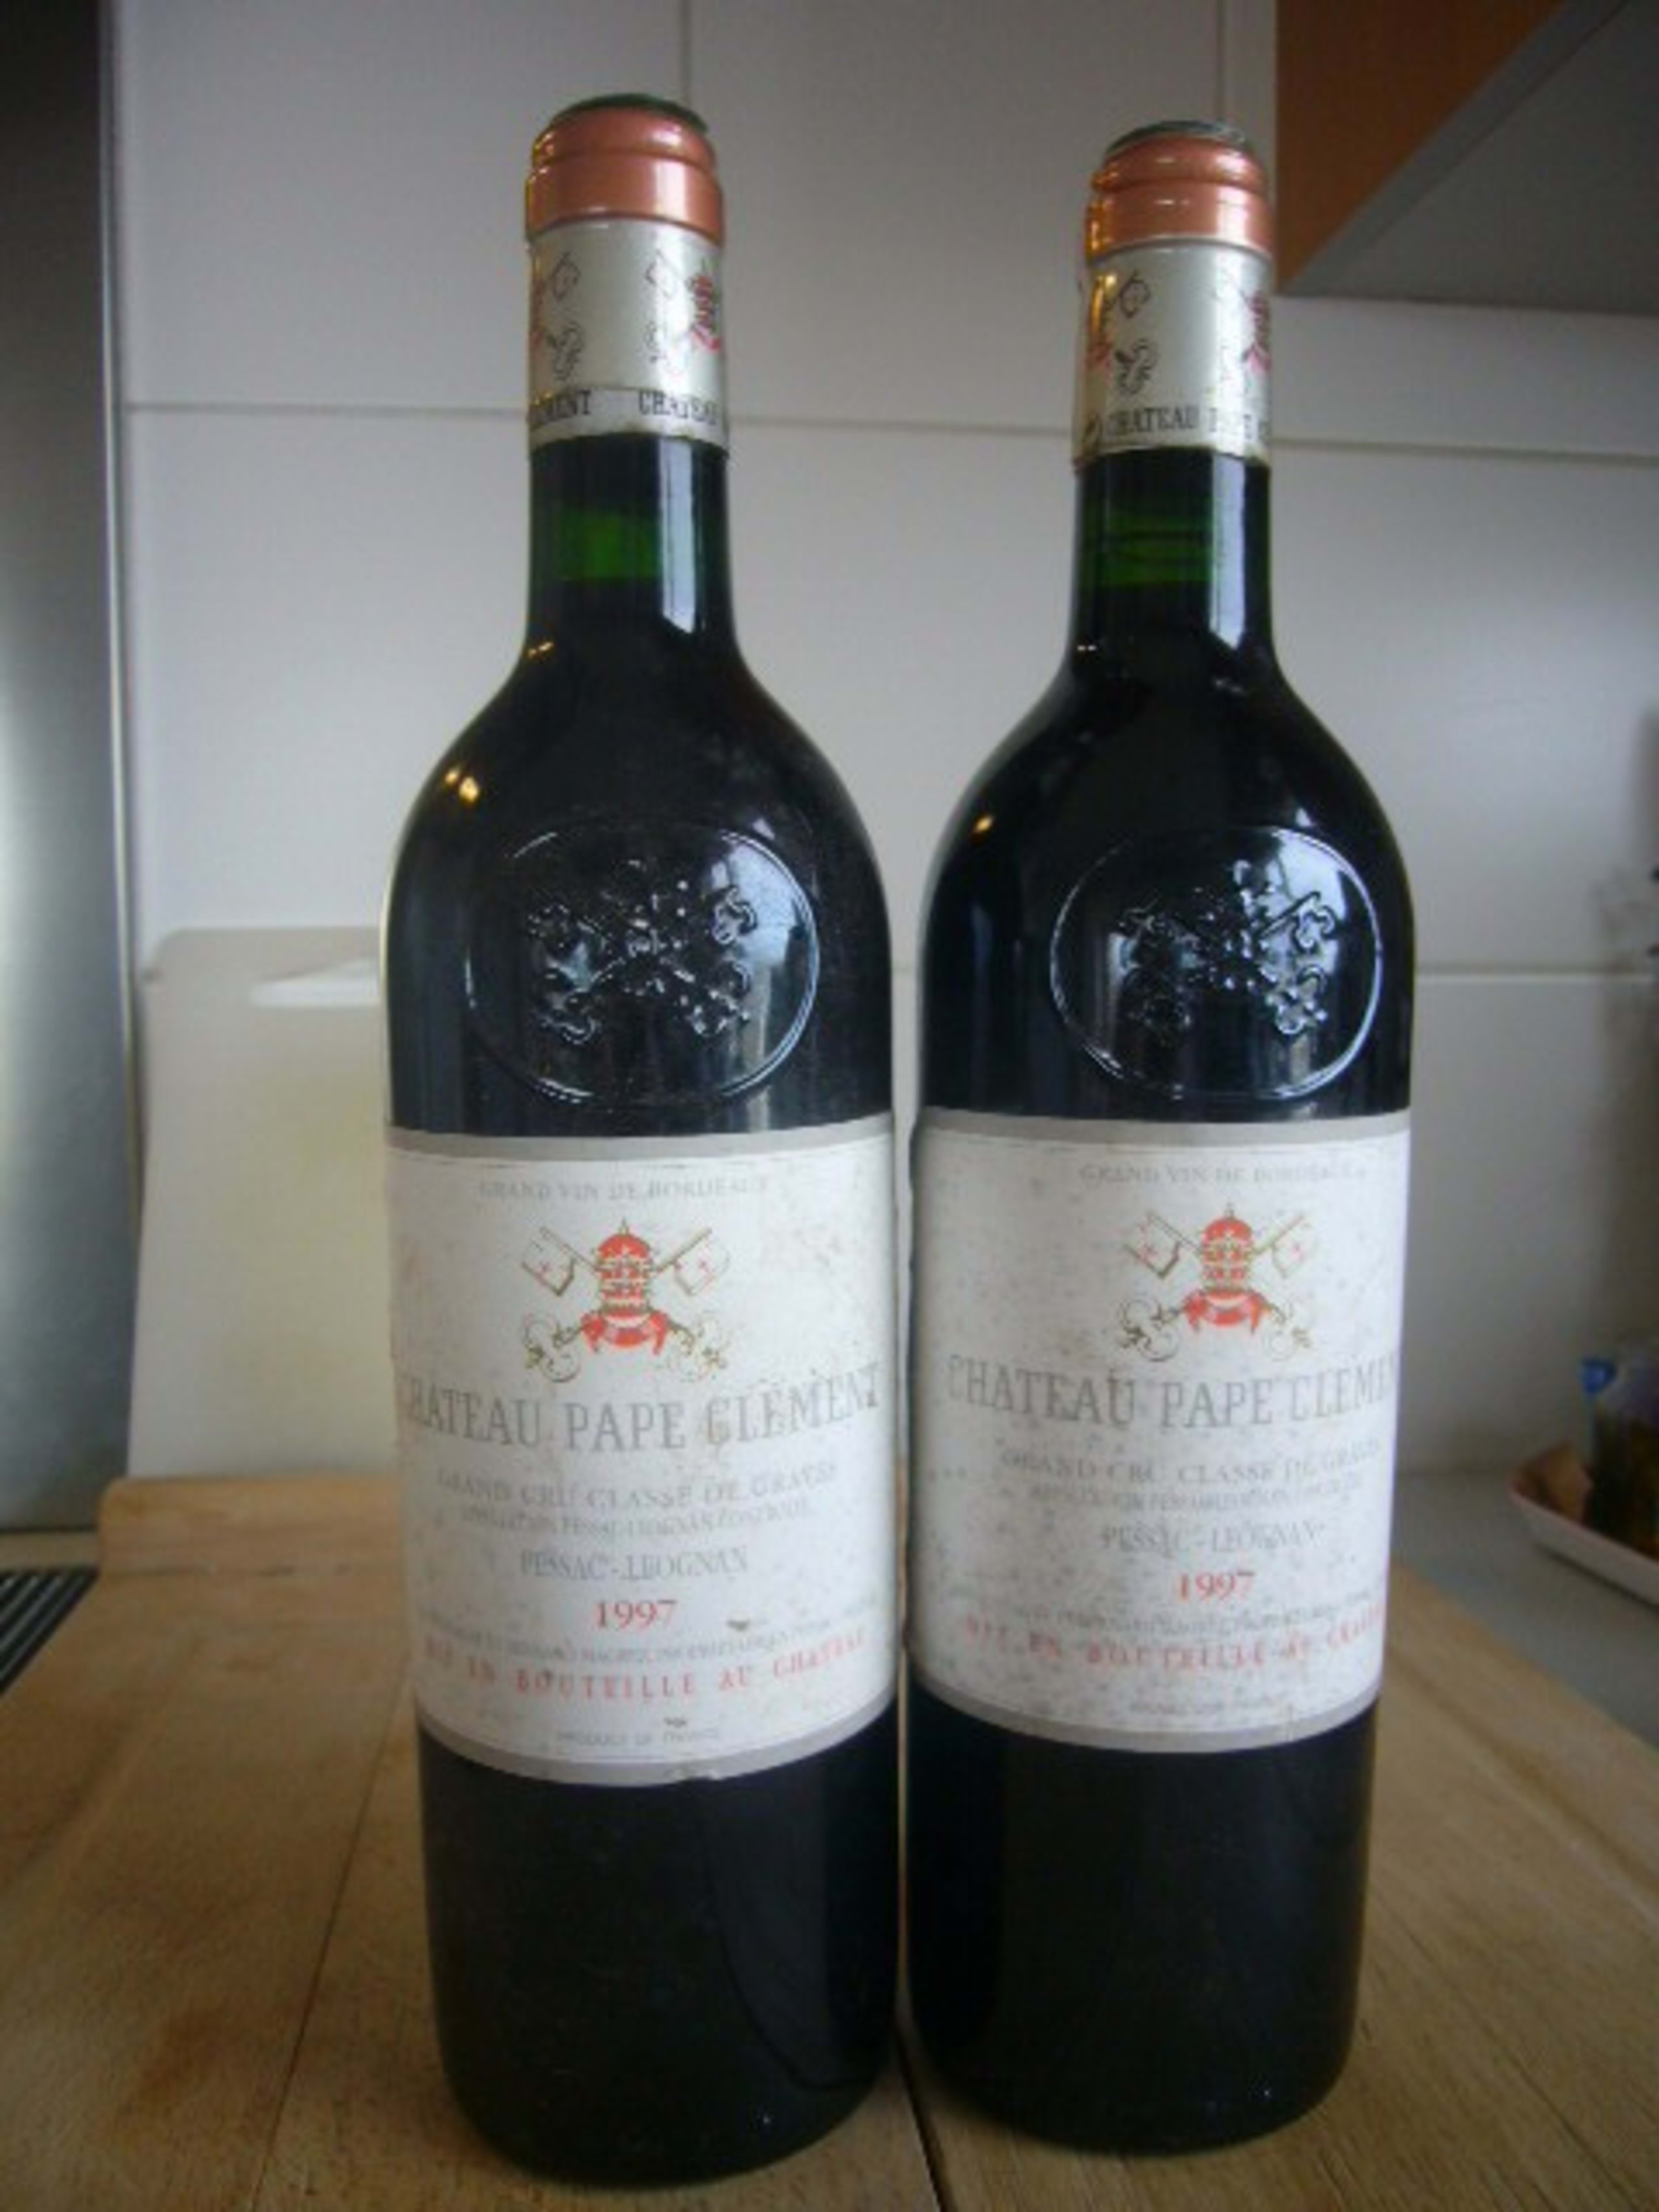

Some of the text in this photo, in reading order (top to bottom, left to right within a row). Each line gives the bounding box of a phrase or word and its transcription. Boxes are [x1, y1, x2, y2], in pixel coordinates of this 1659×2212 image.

[948, 1353, 1135, 1432] CHATEAU
[1160, 1377, 1274, 1428] PAPE
[561, 1400, 686, 1453] PAPE
[1176, 1570, 1256, 1602] 1997
[595, 1597, 678, 1631] 1997
[516, 1667, 695, 1701] BOUTEILLE
[719, 1663, 754, 1690] AU
